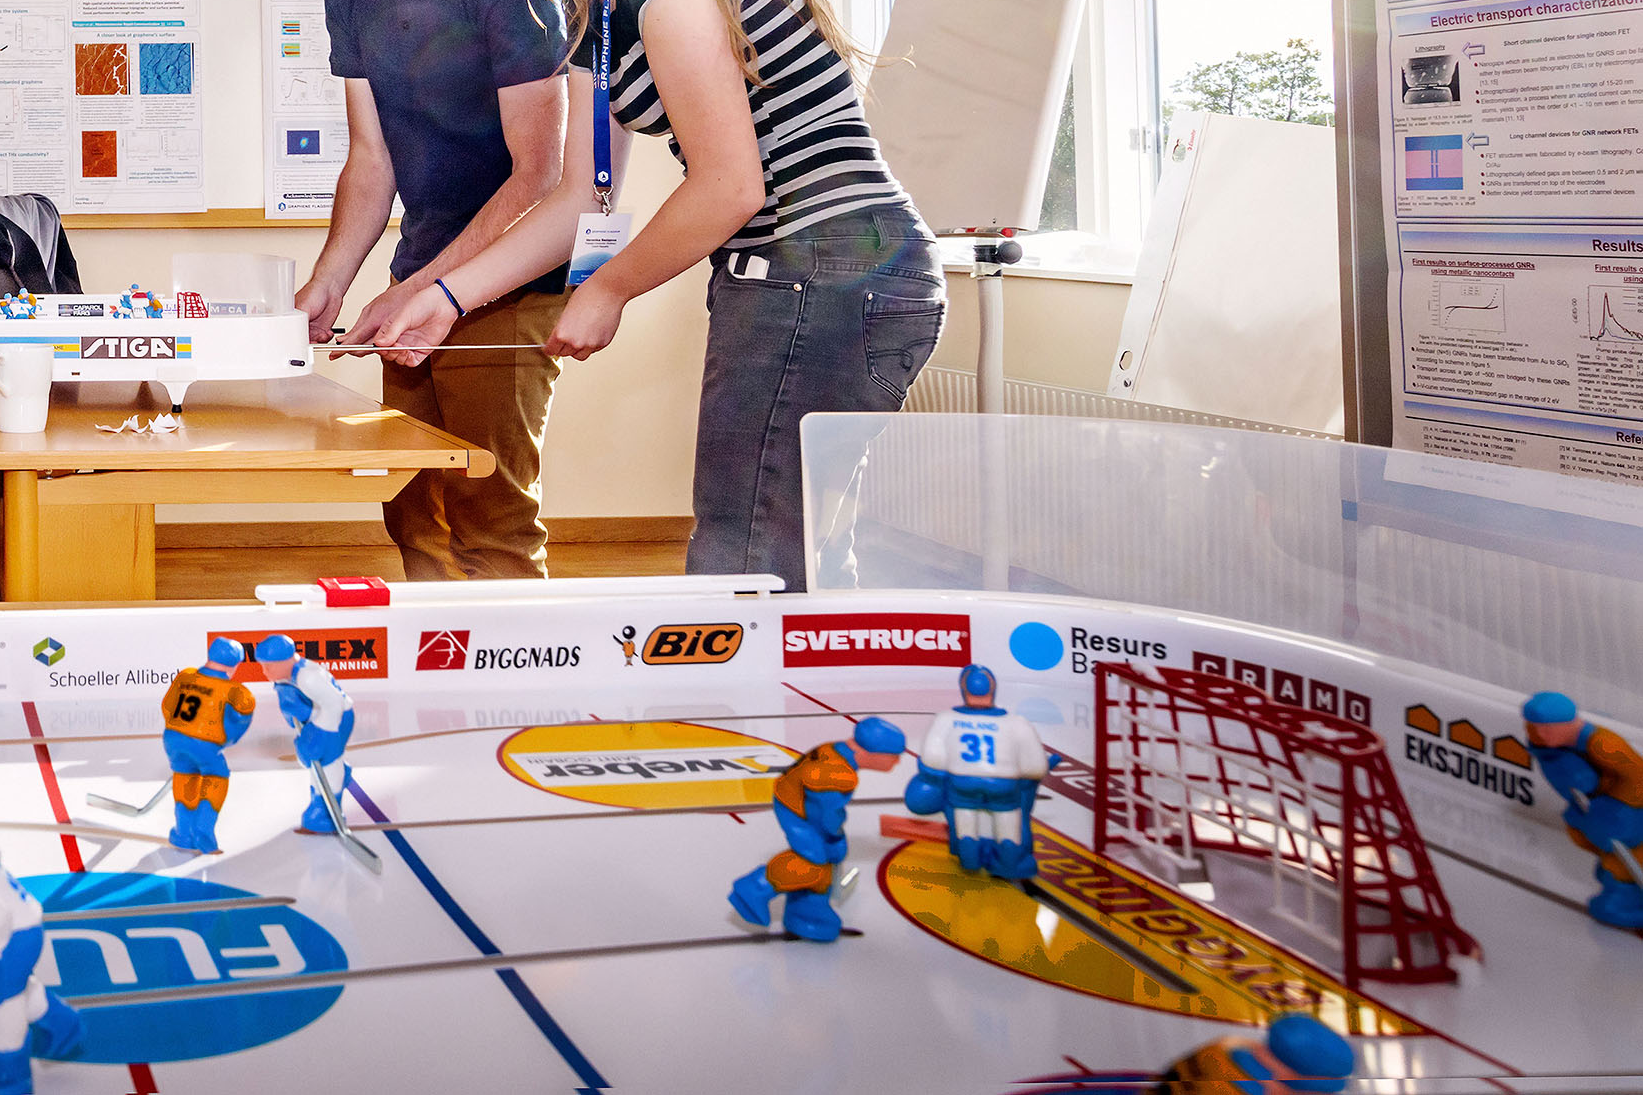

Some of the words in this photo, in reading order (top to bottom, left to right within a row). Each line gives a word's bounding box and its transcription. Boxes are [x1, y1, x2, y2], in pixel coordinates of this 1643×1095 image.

[1430, 12, 1474, 27] Electric
[1477, 5, 1533, 23] transport
[1520, 37, 1542, 45] channel
[1544, 35, 1565, 43] devices
[1577, 32, 1595, 41] single
[1597, 30, 1616, 38] ribbon
[600, 20, 611, 91] GRAPHENE
[1415, 44, 1445, 53] Lithography
[1510, 133, 1523, 141] Long
[1592, 239, 1643, 252] Results
[1412, 258, 1425, 266] First
[1426, 259, 1446, 267] results
[1457, 260, 1514, 269] surface-processed
[1516, 262, 1535, 270] GNRs
[1595, 264, 1611, 272] First
[1613, 265, 1637, 273] results
[1473, 270, 1514, 278] nanocontacts
[83, 338, 174, 357] STIGA
[785, 628, 962, 653] SVETRUCK
[1071, 628, 1168, 660] Resurs
[318, 660, 378, 672] MANNING
[474, 645, 581, 671] BYGGNADS
[49, 671, 120, 687] Schoeller
[173, 693, 201, 722] 13
[960, 733, 996, 765] 31
[543, 759, 748, 779] weber
[1406, 733, 1534, 806] EKSJÖHUS
